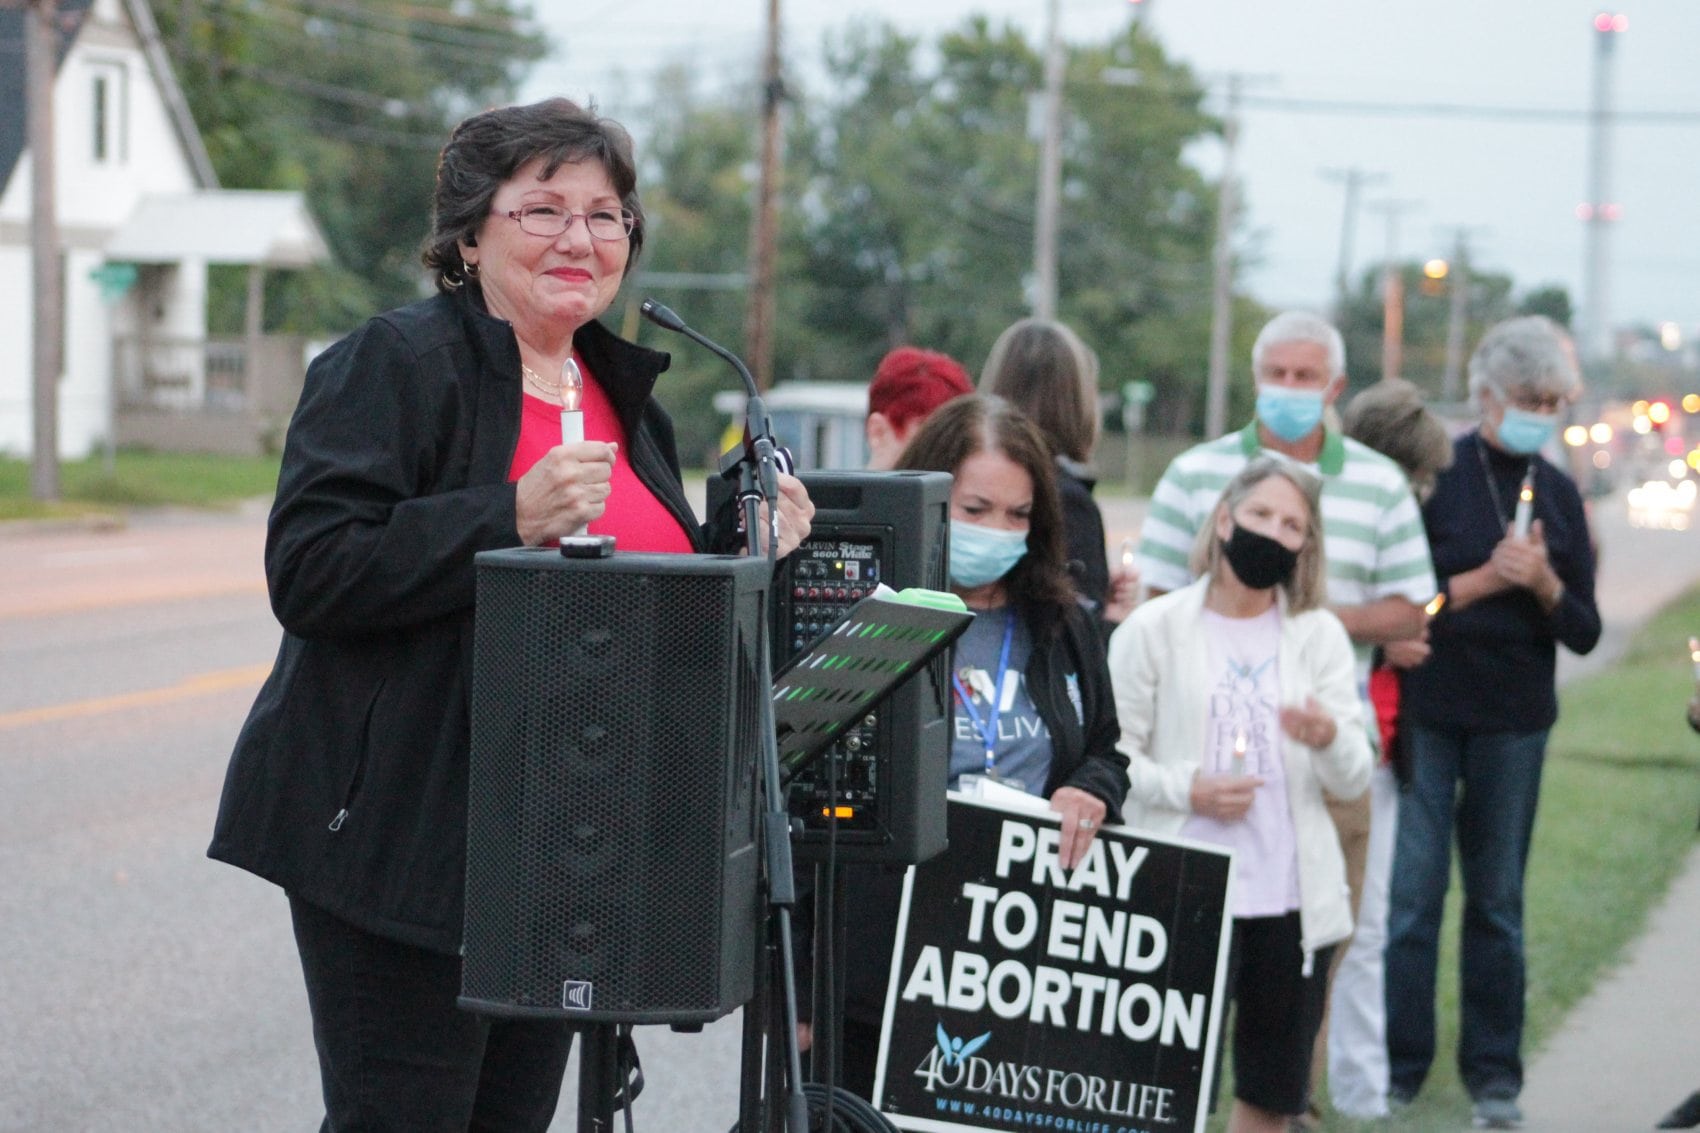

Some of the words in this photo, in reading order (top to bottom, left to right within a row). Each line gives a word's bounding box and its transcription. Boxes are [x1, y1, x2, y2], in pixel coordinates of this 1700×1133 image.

[839, 541, 874, 551] Stage
[996, 819, 1148, 900] PRAY
[962, 882, 1039, 951] TO
[1047, 899, 1168, 974] END
[902, 945, 1206, 1051] ABORTION
[936, 1097, 1150, 1133] WWW.40DAYSFORLIFEC
[966, 1056, 1042, 1101] DAYS
[1043, 1068, 1108, 1114] FOR
[1109, 1079, 1174, 1122] LIFE
